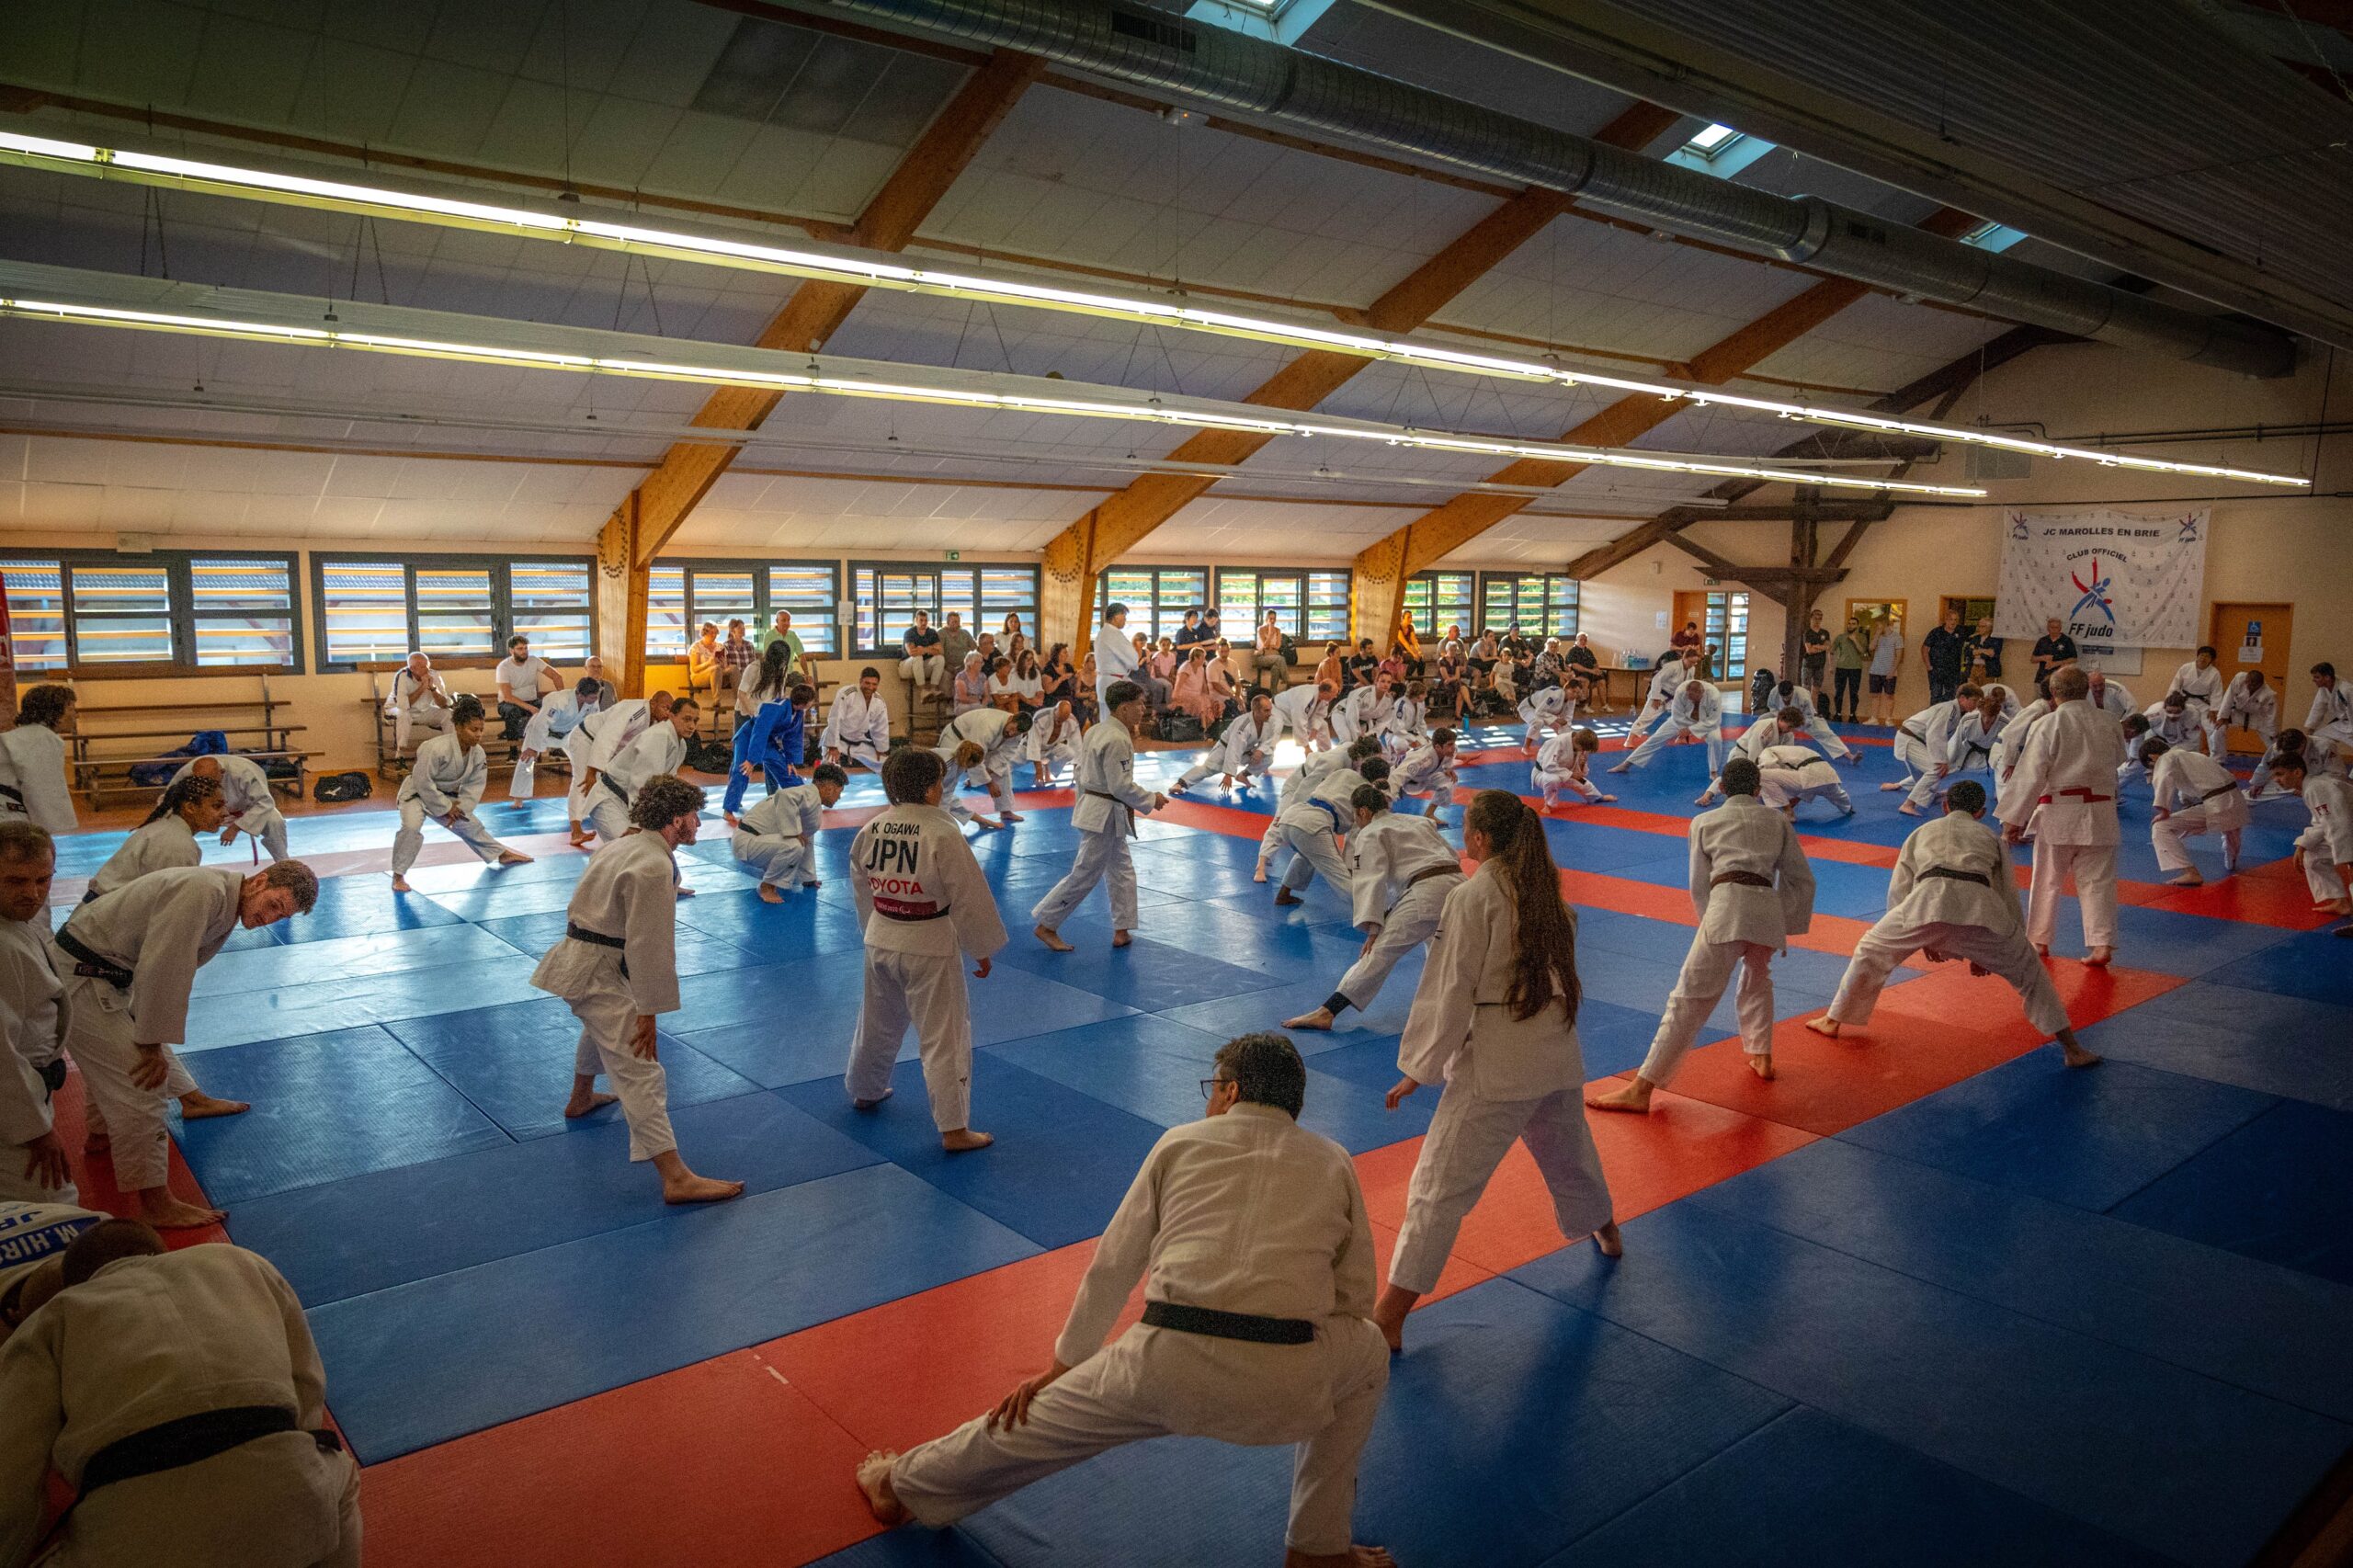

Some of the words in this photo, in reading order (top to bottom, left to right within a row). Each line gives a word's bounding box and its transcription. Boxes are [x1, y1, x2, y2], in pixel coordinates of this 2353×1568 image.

[2059, 528, 2114, 536] MAROLLES
[2134, 528, 2161, 538] BRIE
[2066, 549, 2089, 561] CLUB
[2091, 548, 2128, 562] OFFICIEL
[2068, 622, 2085, 635] FF
[2084, 622, 2113, 638] judo
[871, 823, 880, 834] K
[883, 823, 920, 836] OGAWA
[866, 838, 919, 874] JPN
[868, 877, 924, 895] OYOTA
